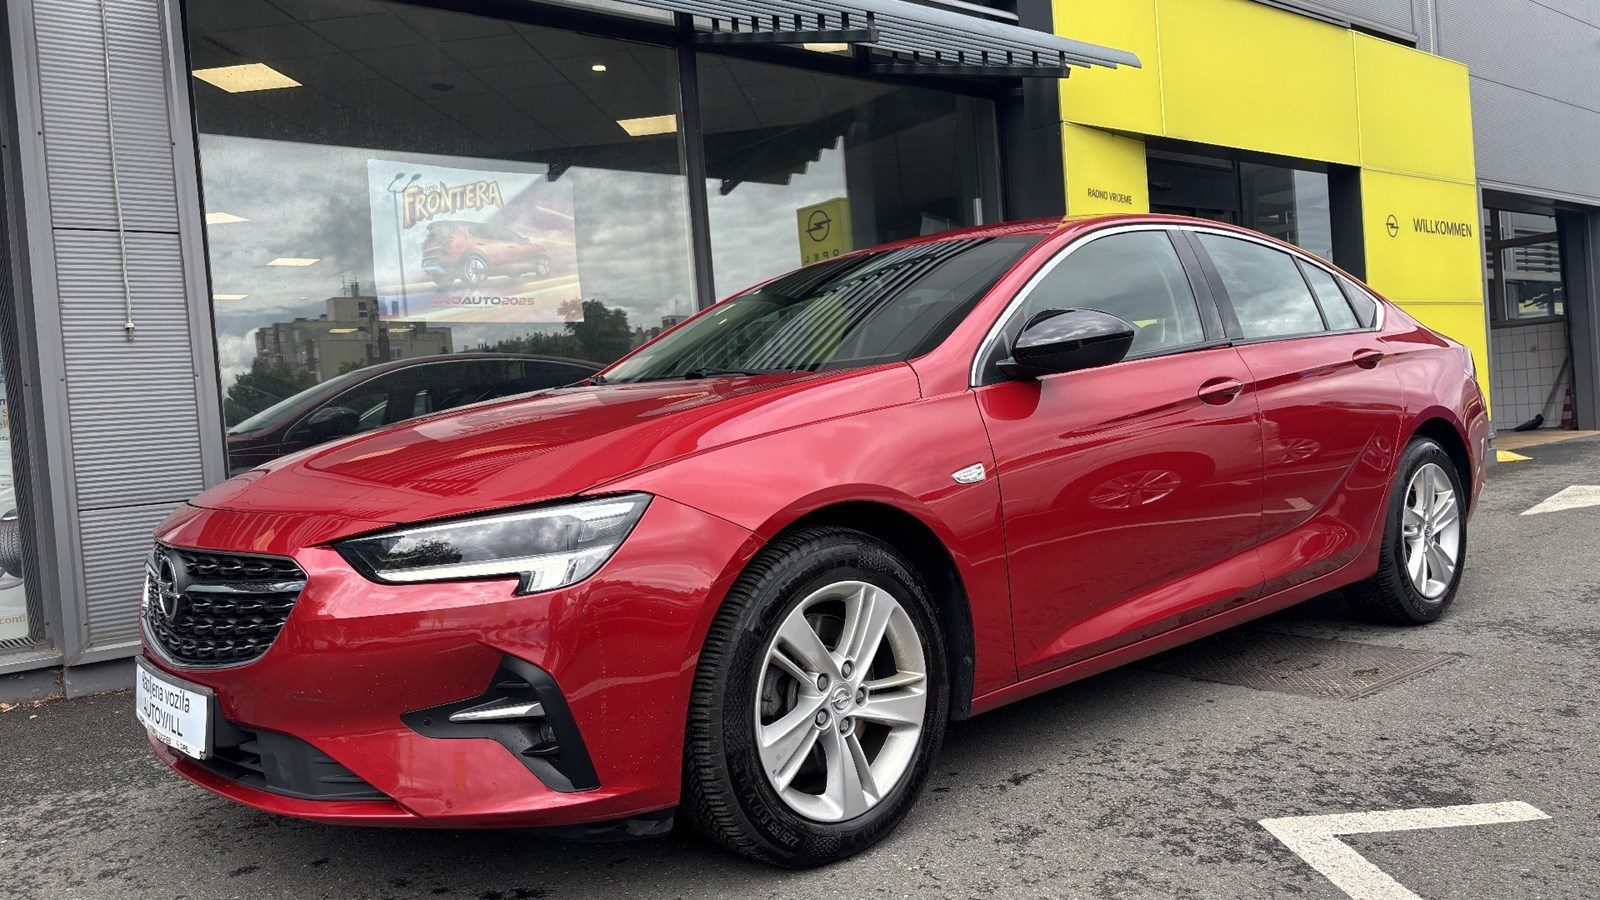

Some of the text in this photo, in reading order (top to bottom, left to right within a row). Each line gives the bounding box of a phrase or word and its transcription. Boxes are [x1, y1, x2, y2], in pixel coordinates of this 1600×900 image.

[403, 180, 504, 229] FRONTERA
[1087, 187, 1133, 205] RADNO VRIJEME
[1412, 217, 1473, 238] WILLKOMMEN
[164, 689, 190, 714] vozila
